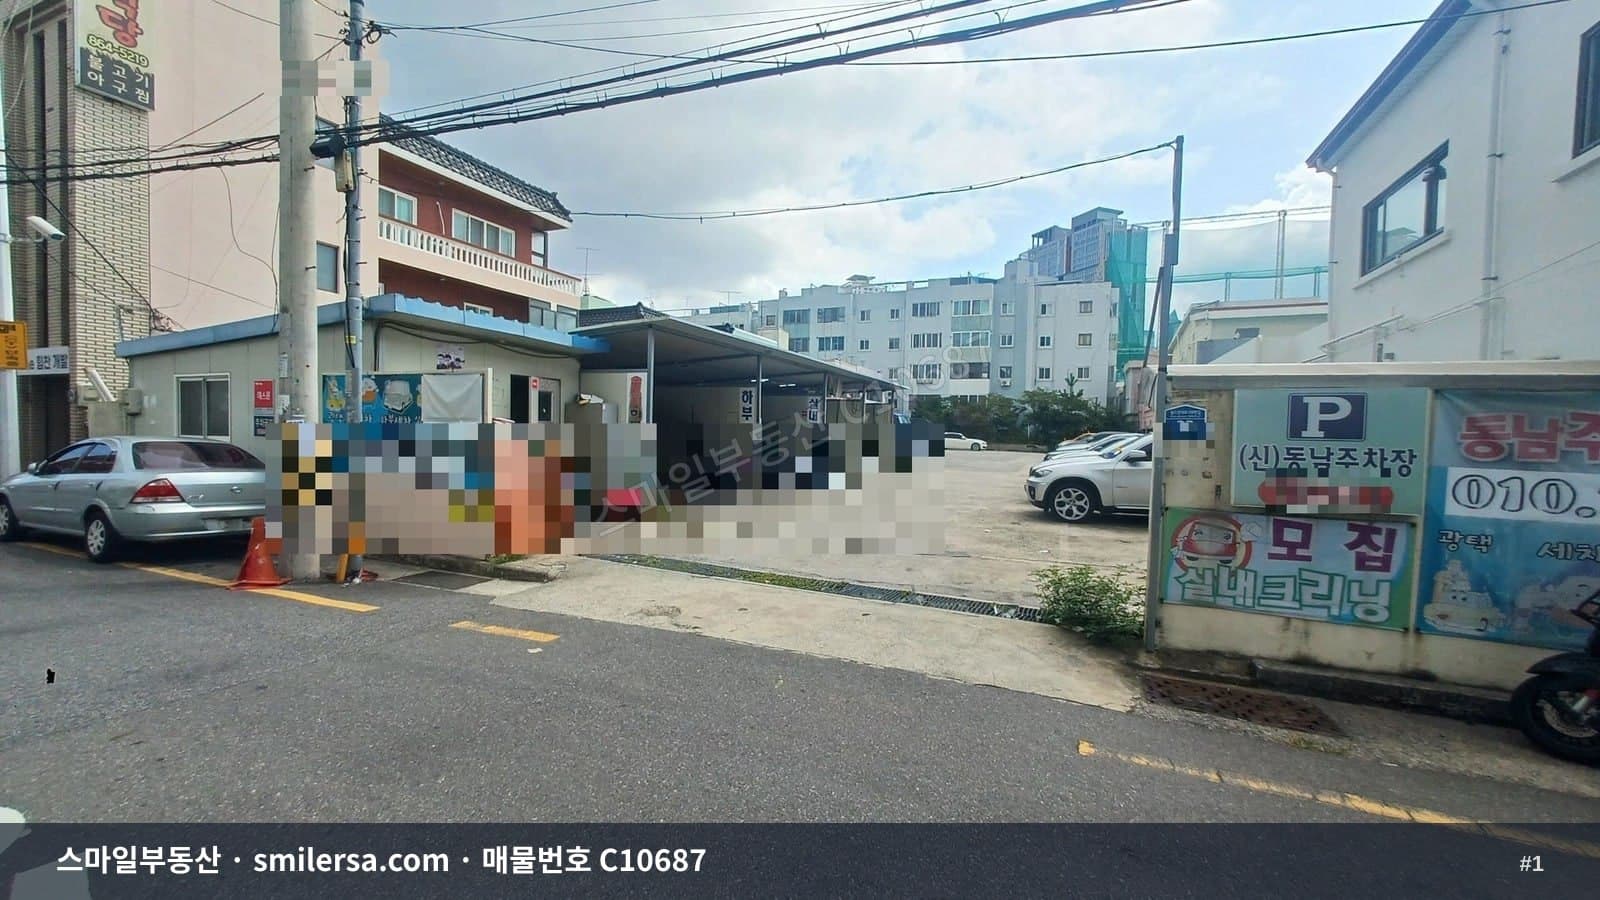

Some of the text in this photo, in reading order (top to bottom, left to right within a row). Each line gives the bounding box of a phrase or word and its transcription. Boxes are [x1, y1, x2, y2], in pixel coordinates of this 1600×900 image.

[741, 390, 754, 421] 하부
[1301, 396, 1353, 438] P
[1458, 410, 1600, 464] 동남주
[1239, 443, 1418, 478] (신)동남주차장
[1452, 474, 1600, 518] 010.
[1439, 530, 1494, 554] 광택
[1174, 564, 1392, 623] 실내크리닝
